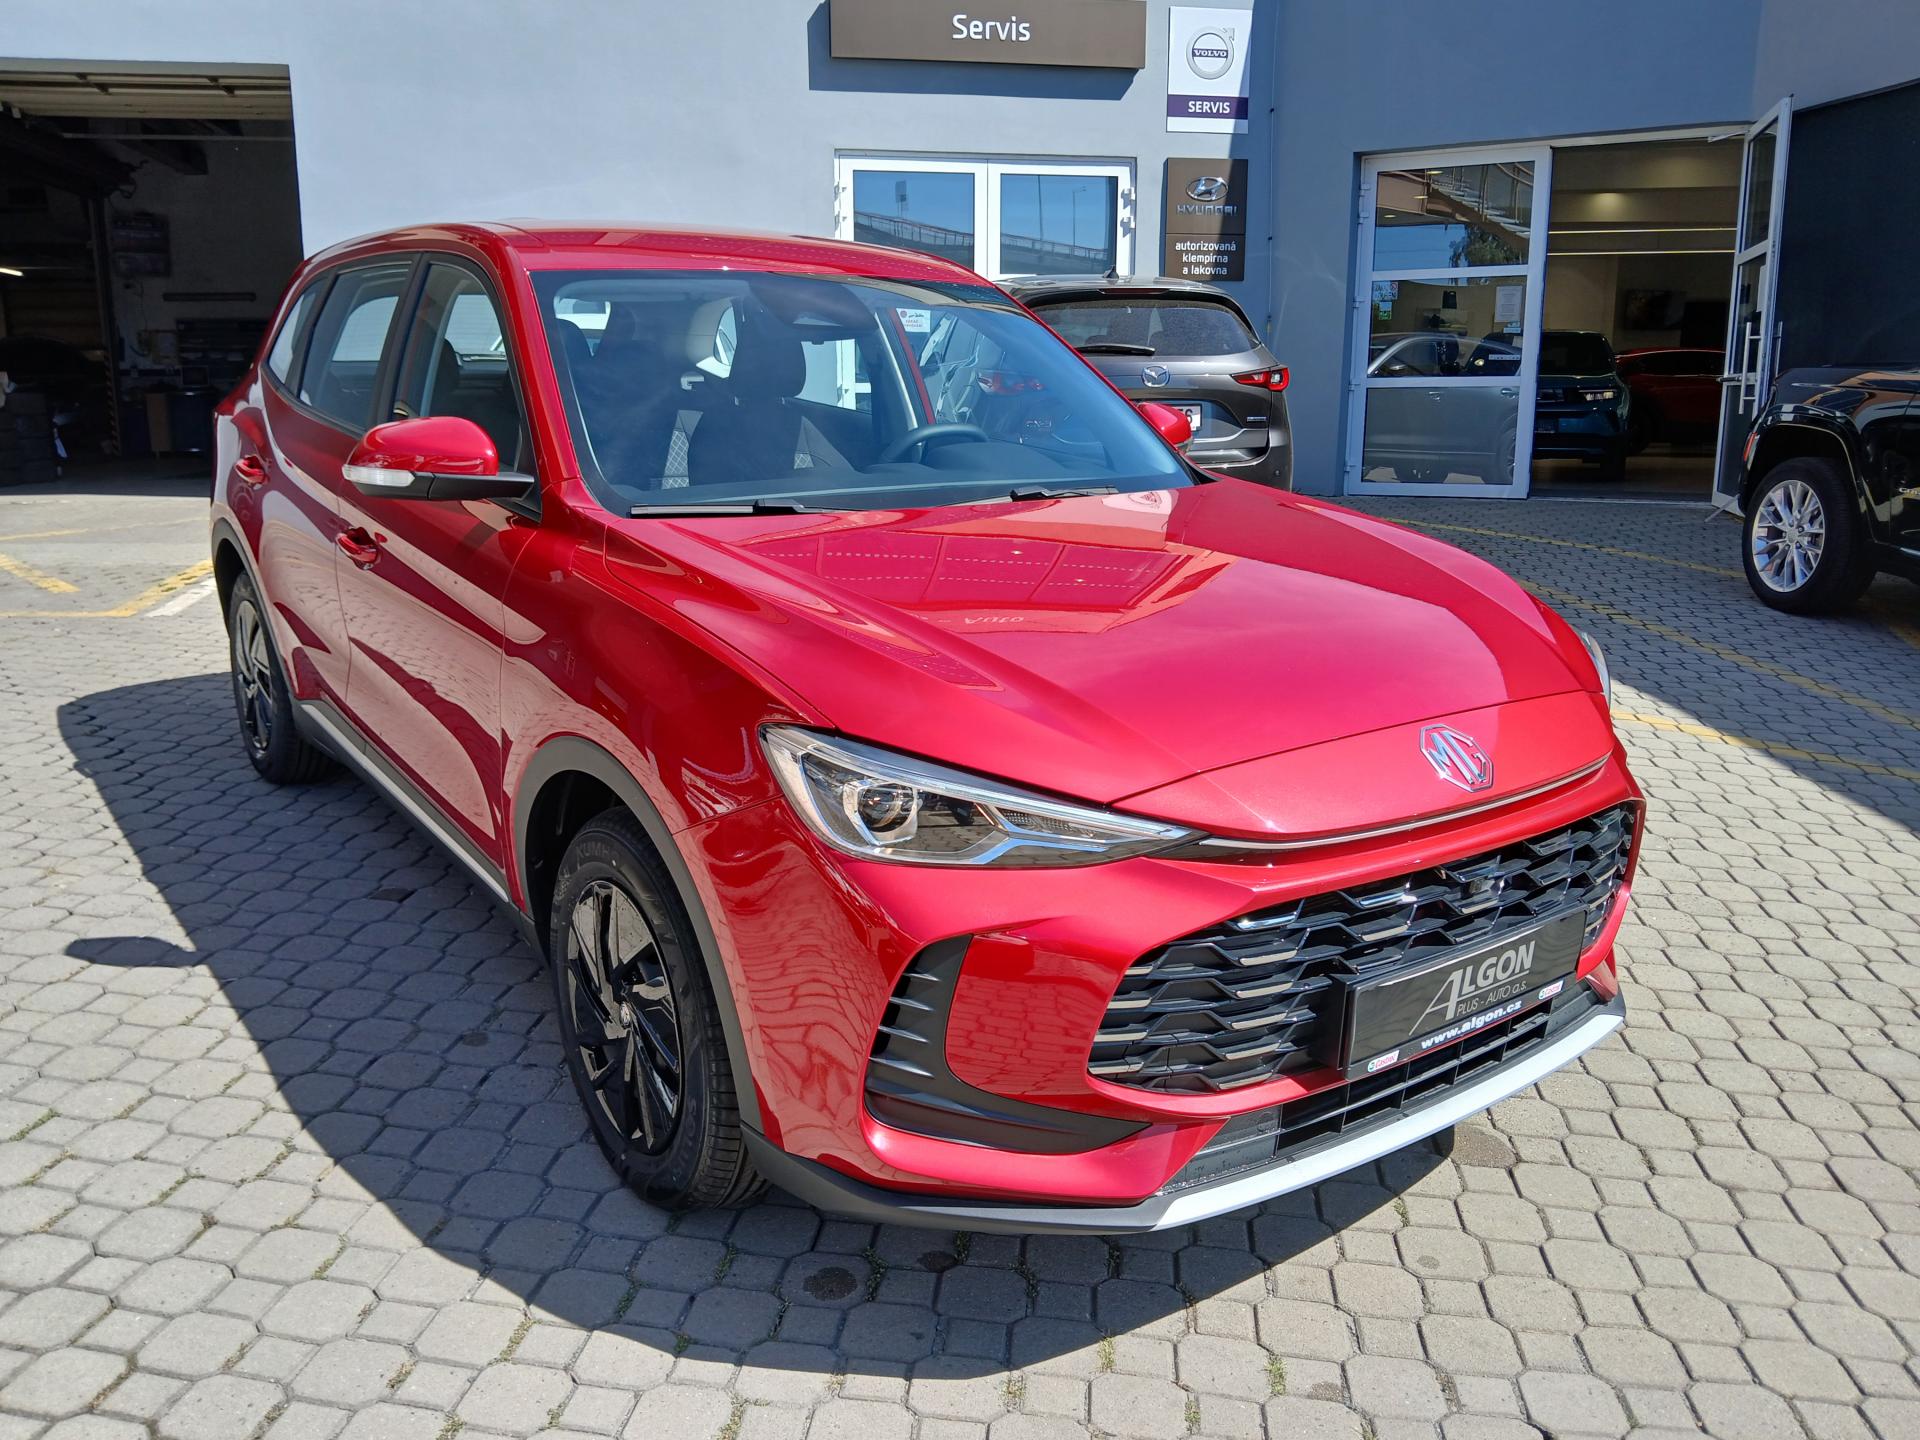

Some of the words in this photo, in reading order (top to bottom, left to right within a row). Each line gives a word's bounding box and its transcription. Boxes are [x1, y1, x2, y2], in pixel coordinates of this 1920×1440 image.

[952, 14, 1031, 42] Servis
[1193, 49, 1228, 57] VOLVO
[1187, 100, 1231, 114] SERVIS
[1176, 204, 1238, 216] HYUNDAI
[1175, 240, 1237, 251] autorizovaná
[1182, 252, 1229, 265] klempírna
[1182, 266, 1189, 275] a
[1191, 264, 1228, 275] lakovna
[1425, 729, 1488, 785] MG
[1407, 939, 1536, 1036] ALGON
[1456, 998, 1478, 1017] PLUS
[1485, 985, 1511, 1006] AUTO
[1420, 998, 1523, 1049] www.algon.cz
